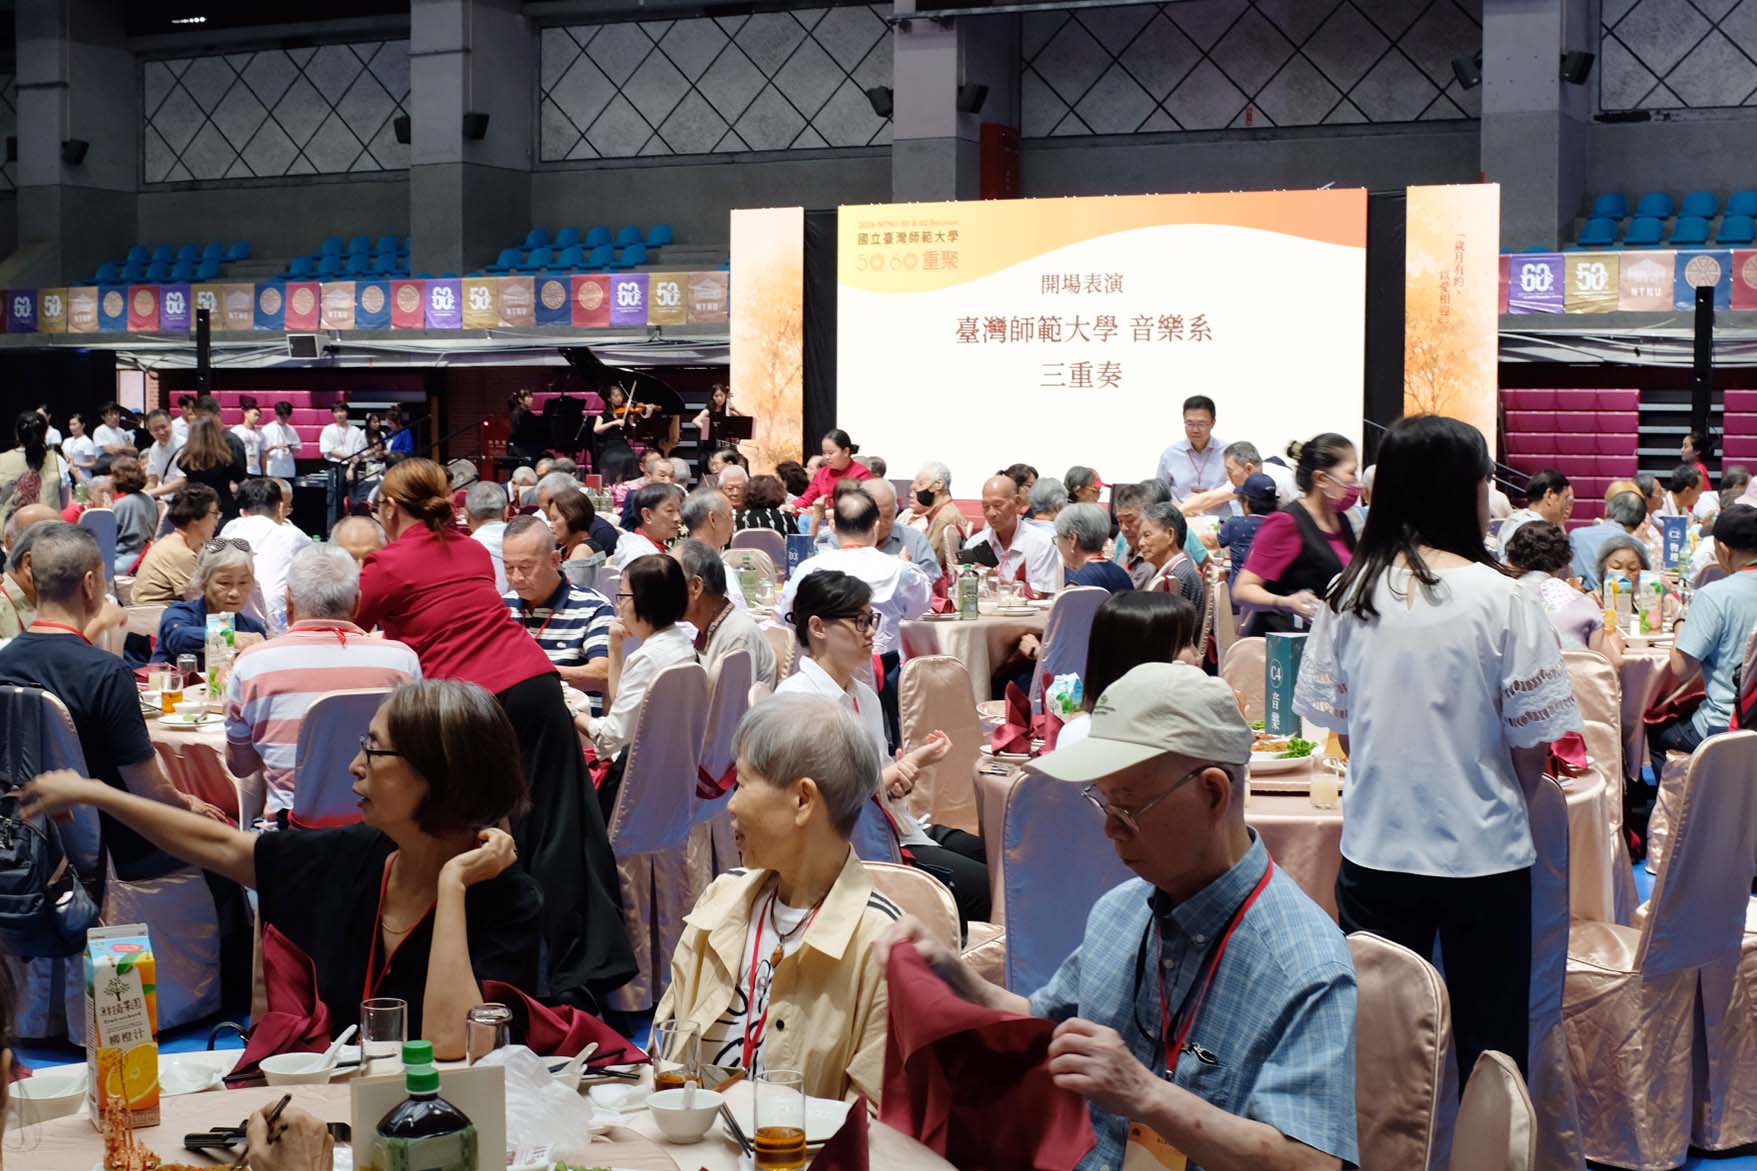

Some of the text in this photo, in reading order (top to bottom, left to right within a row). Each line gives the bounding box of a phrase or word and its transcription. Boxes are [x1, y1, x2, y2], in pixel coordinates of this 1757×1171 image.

[857, 230, 959, 245] 國立臺灣師範大學
[923, 251, 959, 271] 重聚
[1041, 273, 1124, 294] 開場表演
[955, 313, 1213, 344] 臺灣師範大學 音樂系
[1040, 360, 1123, 389] 三重奏
